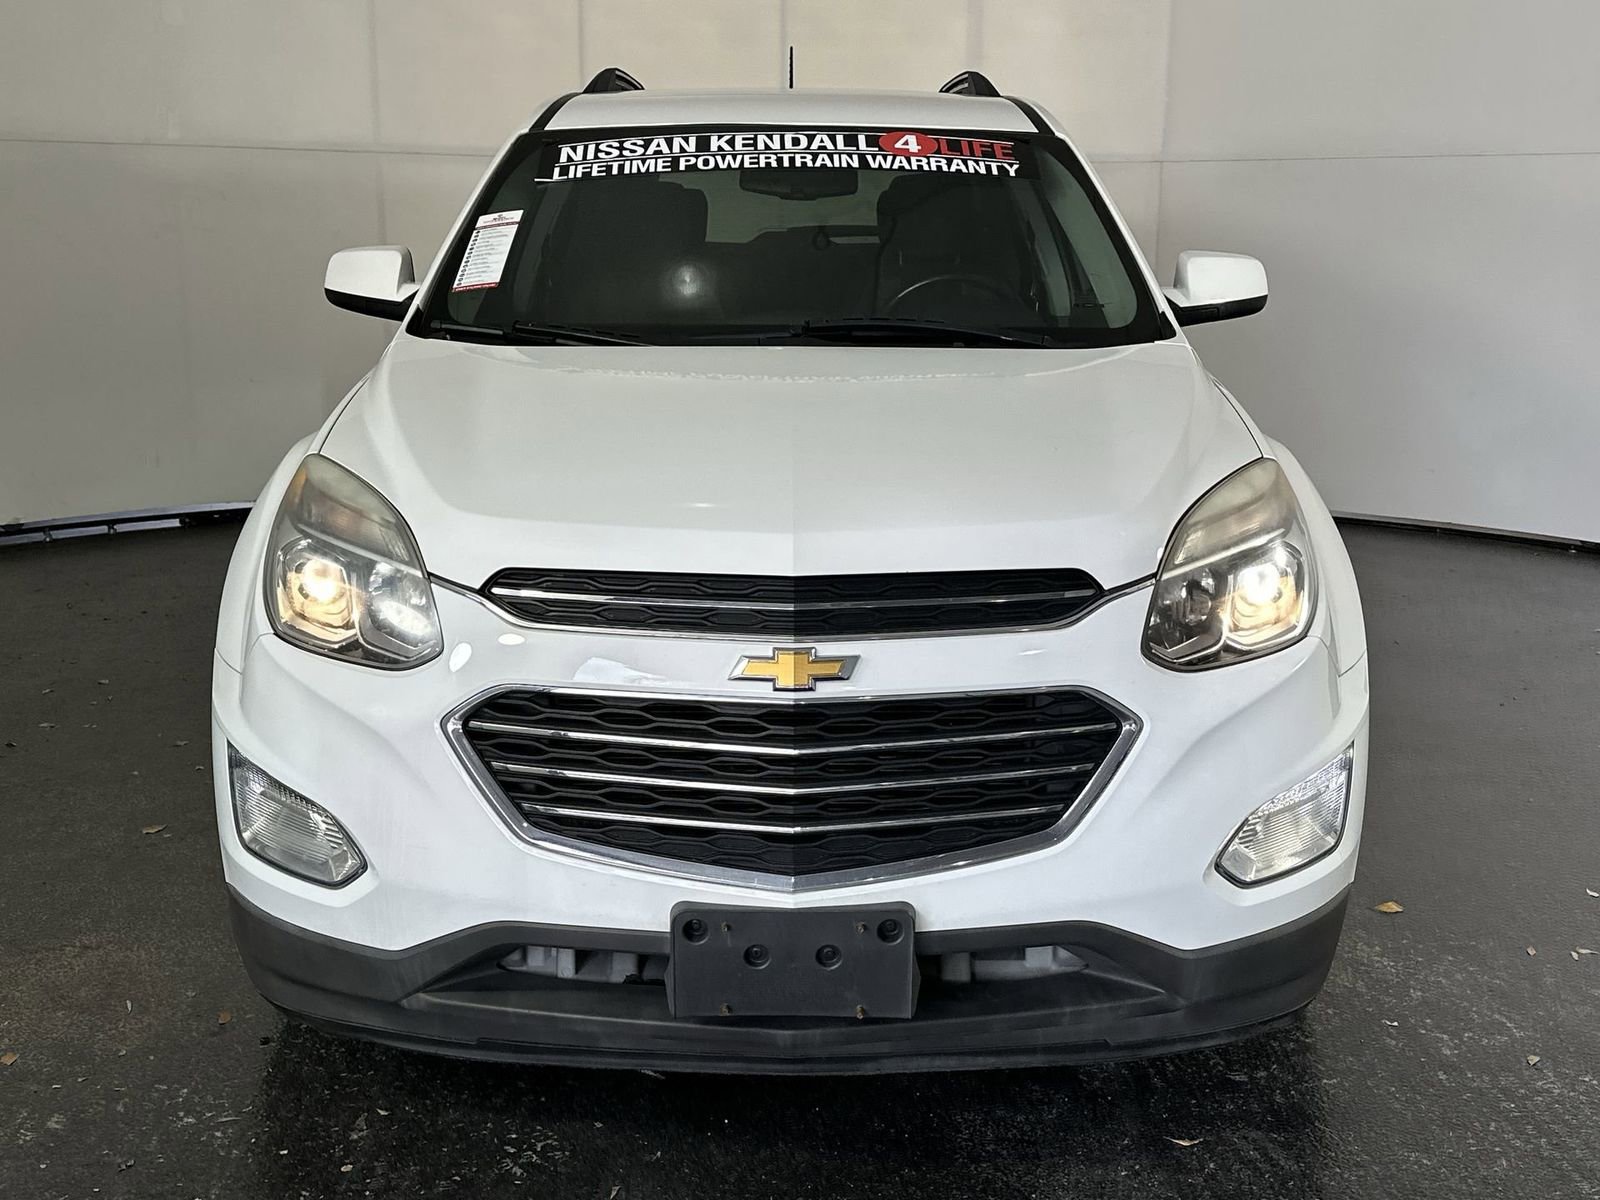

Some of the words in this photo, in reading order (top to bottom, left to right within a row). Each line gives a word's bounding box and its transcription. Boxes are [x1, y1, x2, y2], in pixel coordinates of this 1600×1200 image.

[558, 136, 697, 163] NISSAN
[709, 134, 879, 151] KENDALL
[894, 133, 922, 153] 4
[937, 138, 1015, 160] LIFE
[553, 157, 672, 180] LIFETIME
[678, 153, 860, 171] POWERTRAIN
[865, 155, 1020, 177] WARRANTY
